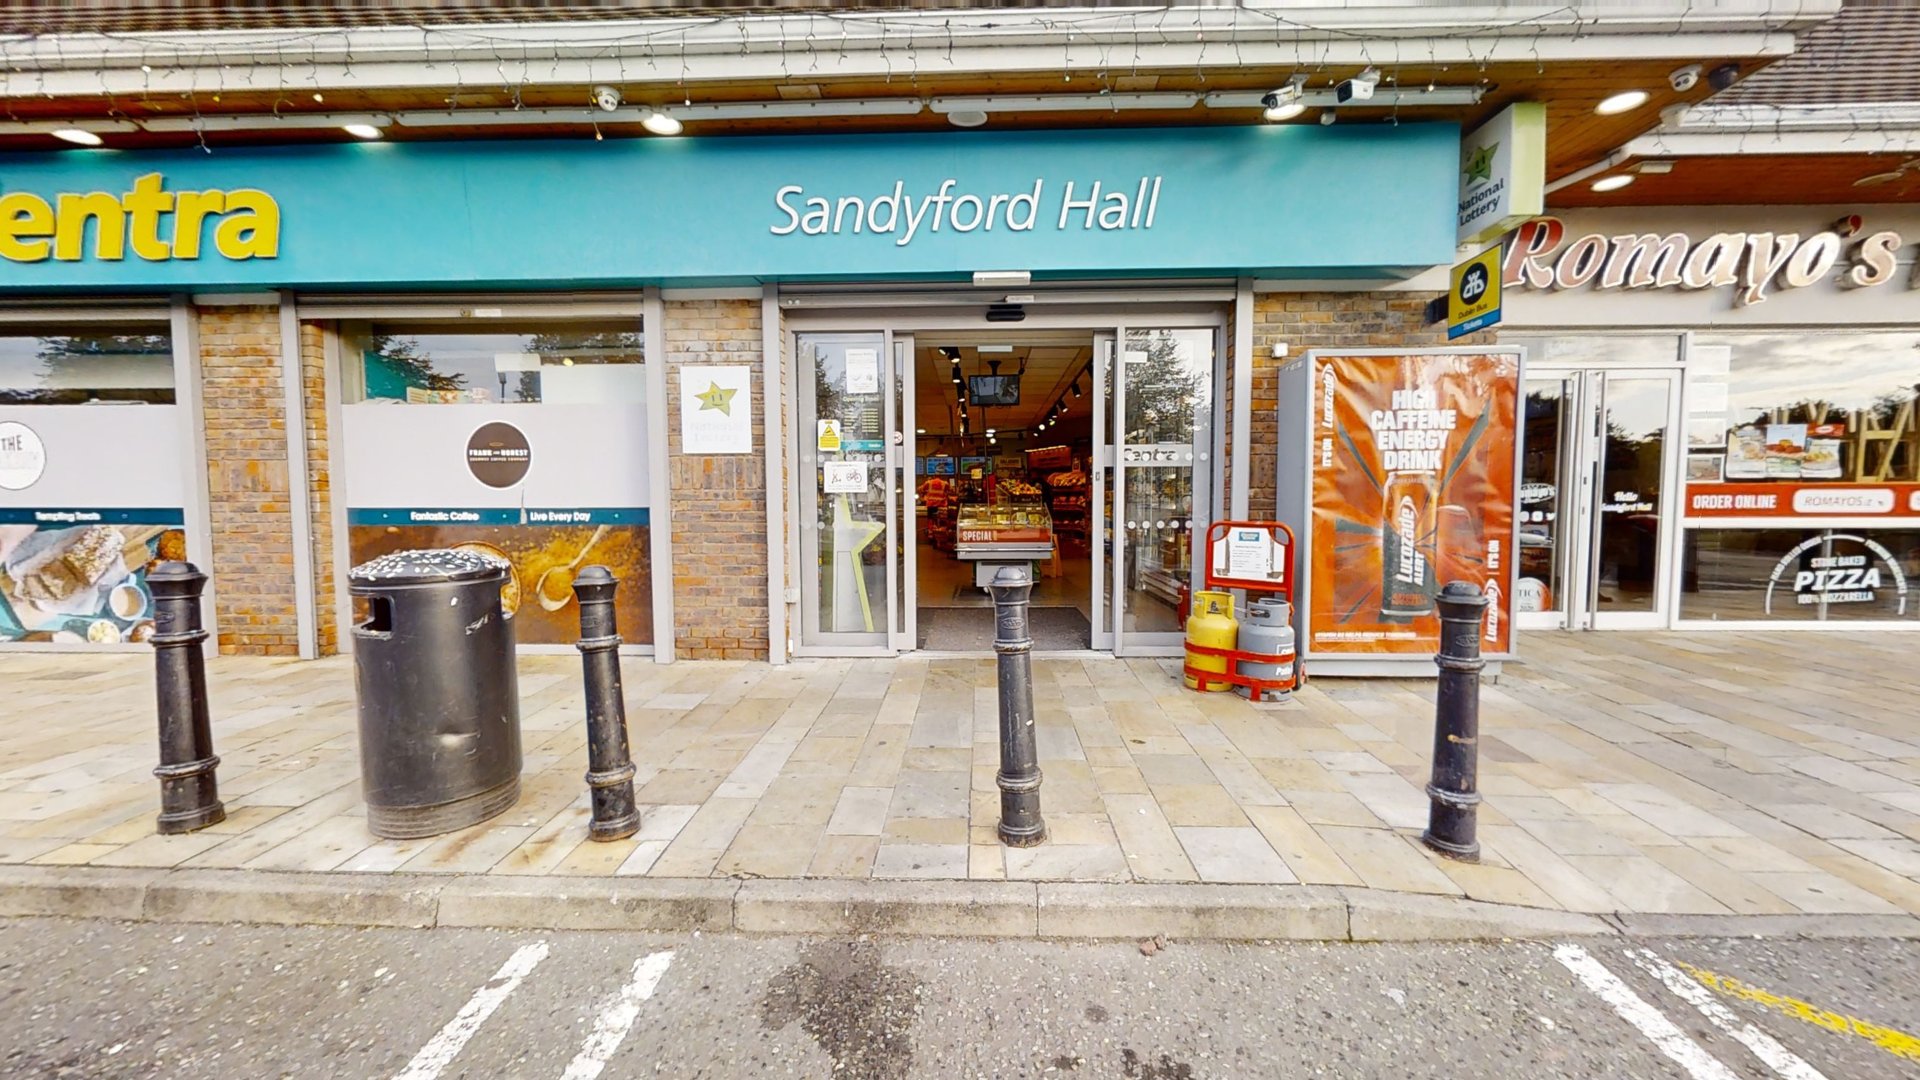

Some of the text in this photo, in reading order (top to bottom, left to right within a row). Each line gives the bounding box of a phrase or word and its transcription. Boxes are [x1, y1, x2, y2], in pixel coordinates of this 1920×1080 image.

[1457, 178, 1504, 215] National
[770, 176, 1162, 247] Sandyford Hall
[1460, 195, 1501, 226] Lottery
[1501, 214, 1902, 305] Romayo's
[1321, 368, 1336, 429] Lucozade
[1392, 389, 1436, 409] HIGH
[1371, 410, 1456, 430] CAFFEINE
[2, 435, 22, 451] THE
[1378, 431, 1449, 450] ENERGY
[1384, 451, 1442, 470] DRINK
[1693, 494, 1778, 509] ORDER ONLINE
[410, 511, 480, 521] Fantastic Coffee
[530, 511, 591, 523] Live Every Day
[962, 530, 993, 541] SPECIAL
[1396, 503, 1415, 584] Lucozade
[1414, 551, 1425, 587] ALERT
[1794, 567, 1881, 592] PIZZA
